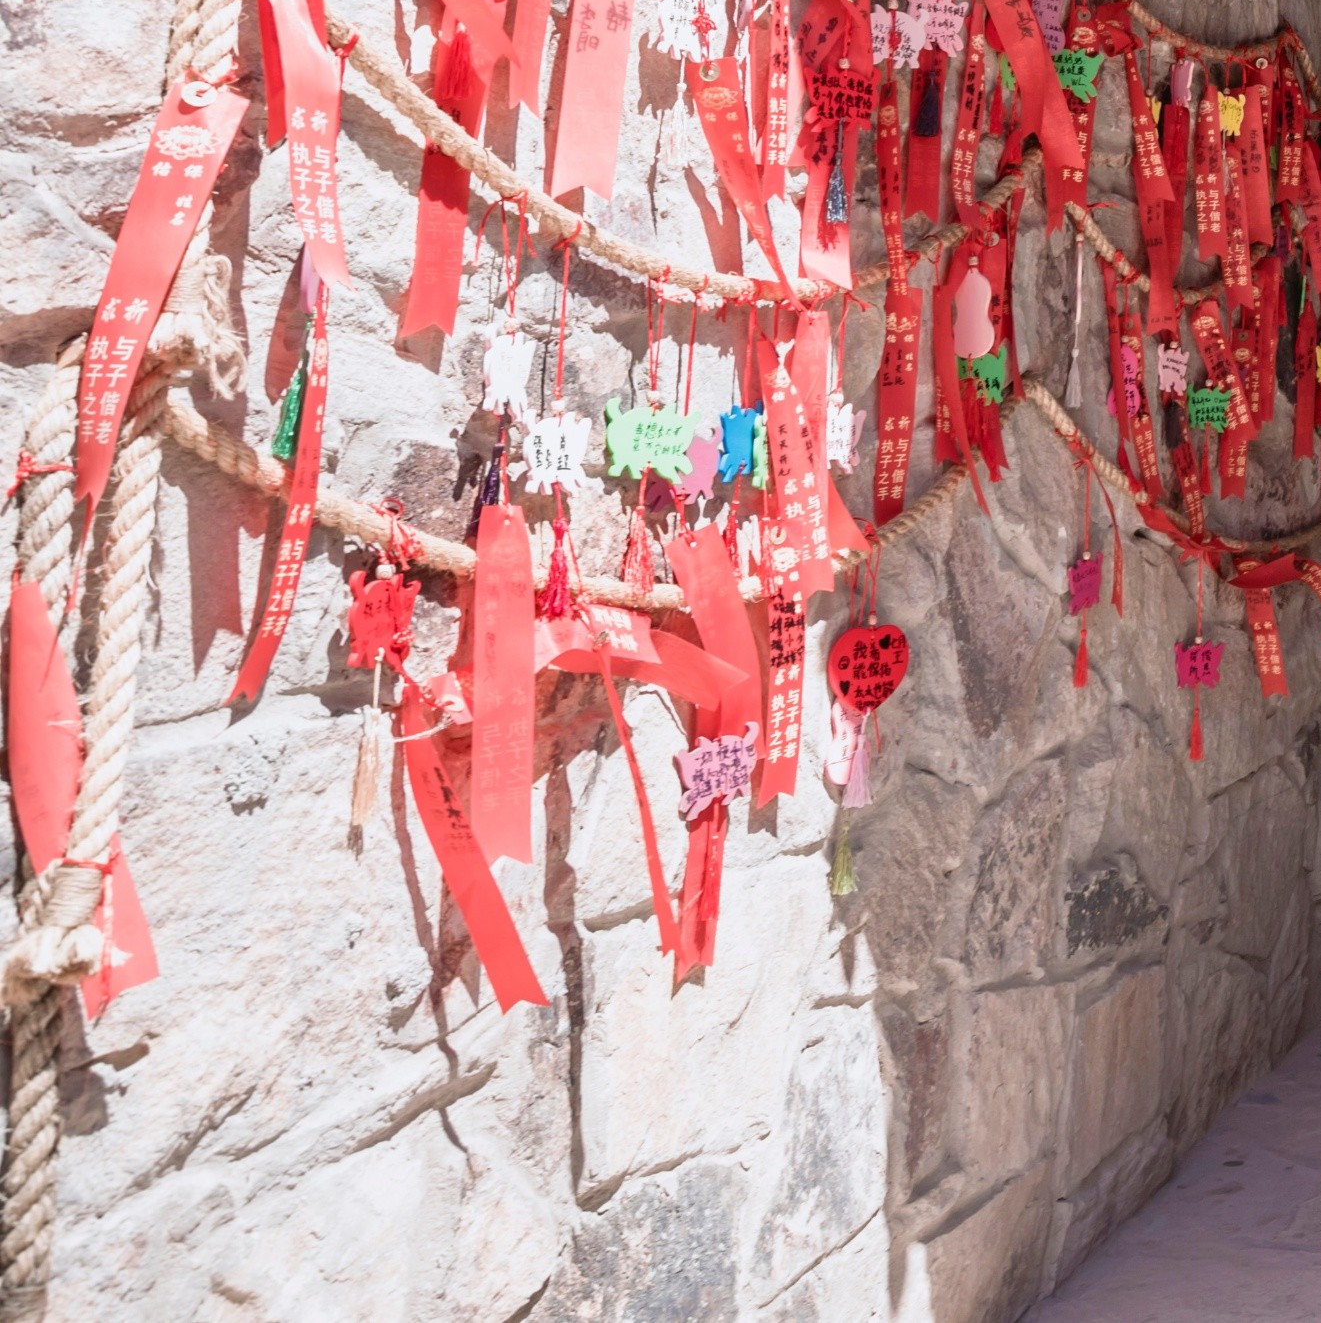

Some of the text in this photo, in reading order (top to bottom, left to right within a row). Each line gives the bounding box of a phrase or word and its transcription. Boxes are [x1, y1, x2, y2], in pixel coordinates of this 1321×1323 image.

[291, 142, 320, 240] 执子之手
[311, 146, 338, 244] 与子偕老
[1208, 189, 1222, 233] 与子偕老
[79, 336, 109, 444] 执子之手
[94, 336, 139, 445] 与子偕老
[877, 439, 895, 501] 执子之手
[890, 438, 908, 500] 与子偕老
[1255, 634, 1271, 674] 执子之手
[1266, 634, 1283, 675] 与子偕老
[769, 694, 786, 764] 执子之手
[781, 688, 801, 759] 与子偕老
